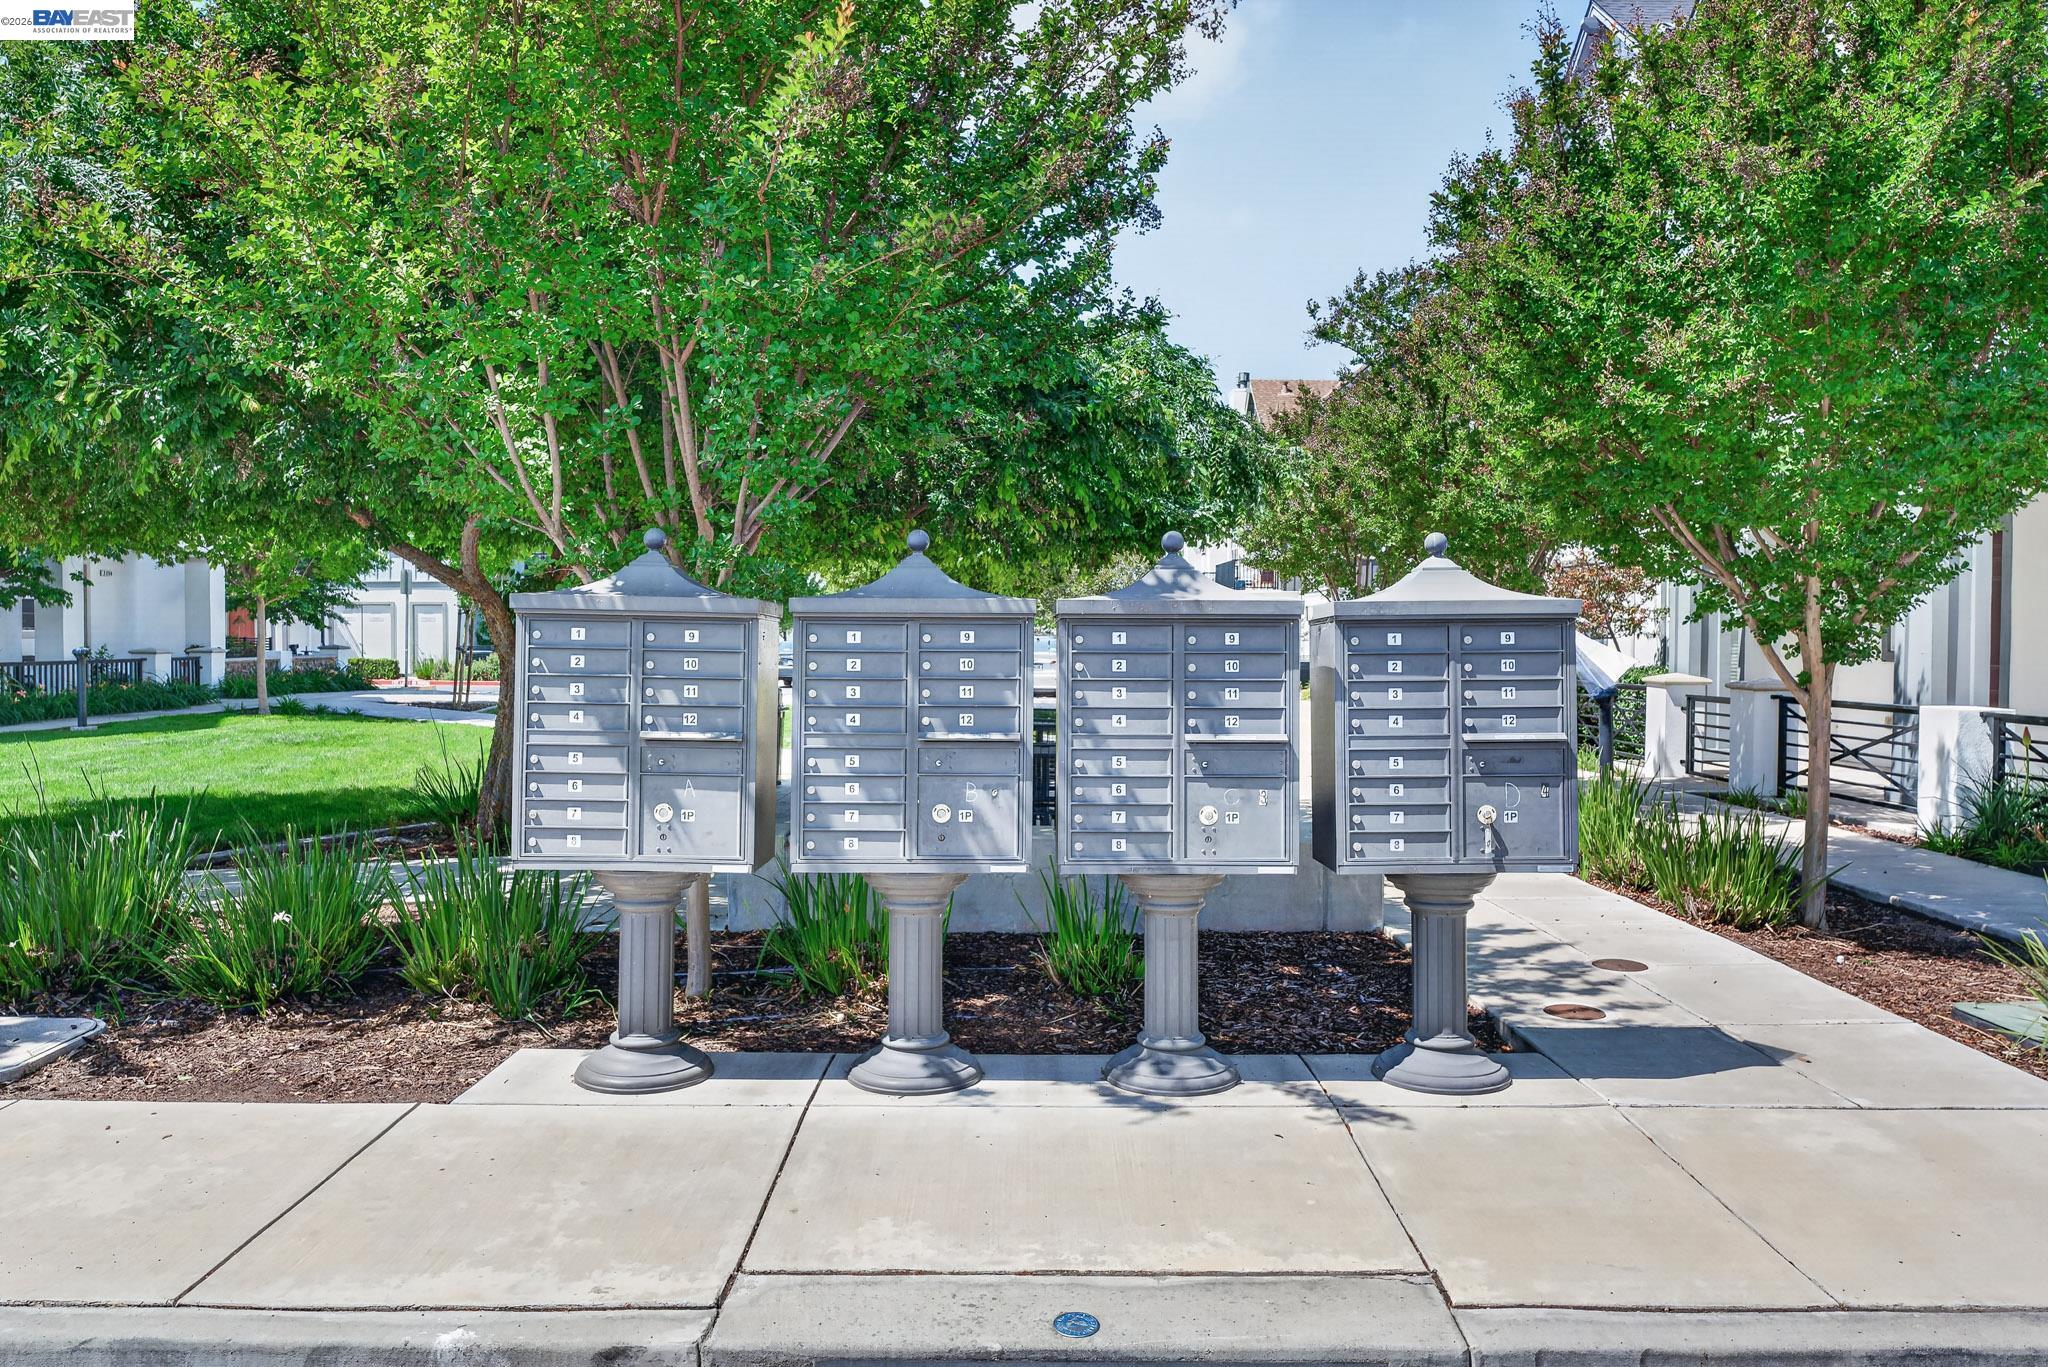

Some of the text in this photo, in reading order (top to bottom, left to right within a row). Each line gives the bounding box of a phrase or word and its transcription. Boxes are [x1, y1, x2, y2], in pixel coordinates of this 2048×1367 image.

[685, 659, 697, 668] 10
[961, 660, 973, 669] 10
[1226, 661, 1238, 671] 10
[1503, 661, 1514, 670] 10
[686, 687, 696, 696] 11
[962, 688, 972, 696] 11
[1227, 689, 1237, 698] 11
[1503, 688, 1513, 698] 11
[684, 715, 696, 724] 12
[961, 715, 972, 724] 12
[1226, 717, 1238, 726] 12
[1503, 716, 1515, 725] 12
[684, 779, 695, 798] A
[966, 781, 977, 802] B
[1505, 782, 1520, 807] D
[682, 811, 694, 820] 1P
[960, 811, 972, 820] 1P
[1226, 813, 1238, 822] 1P
[1504, 812, 1517, 821] 1P
